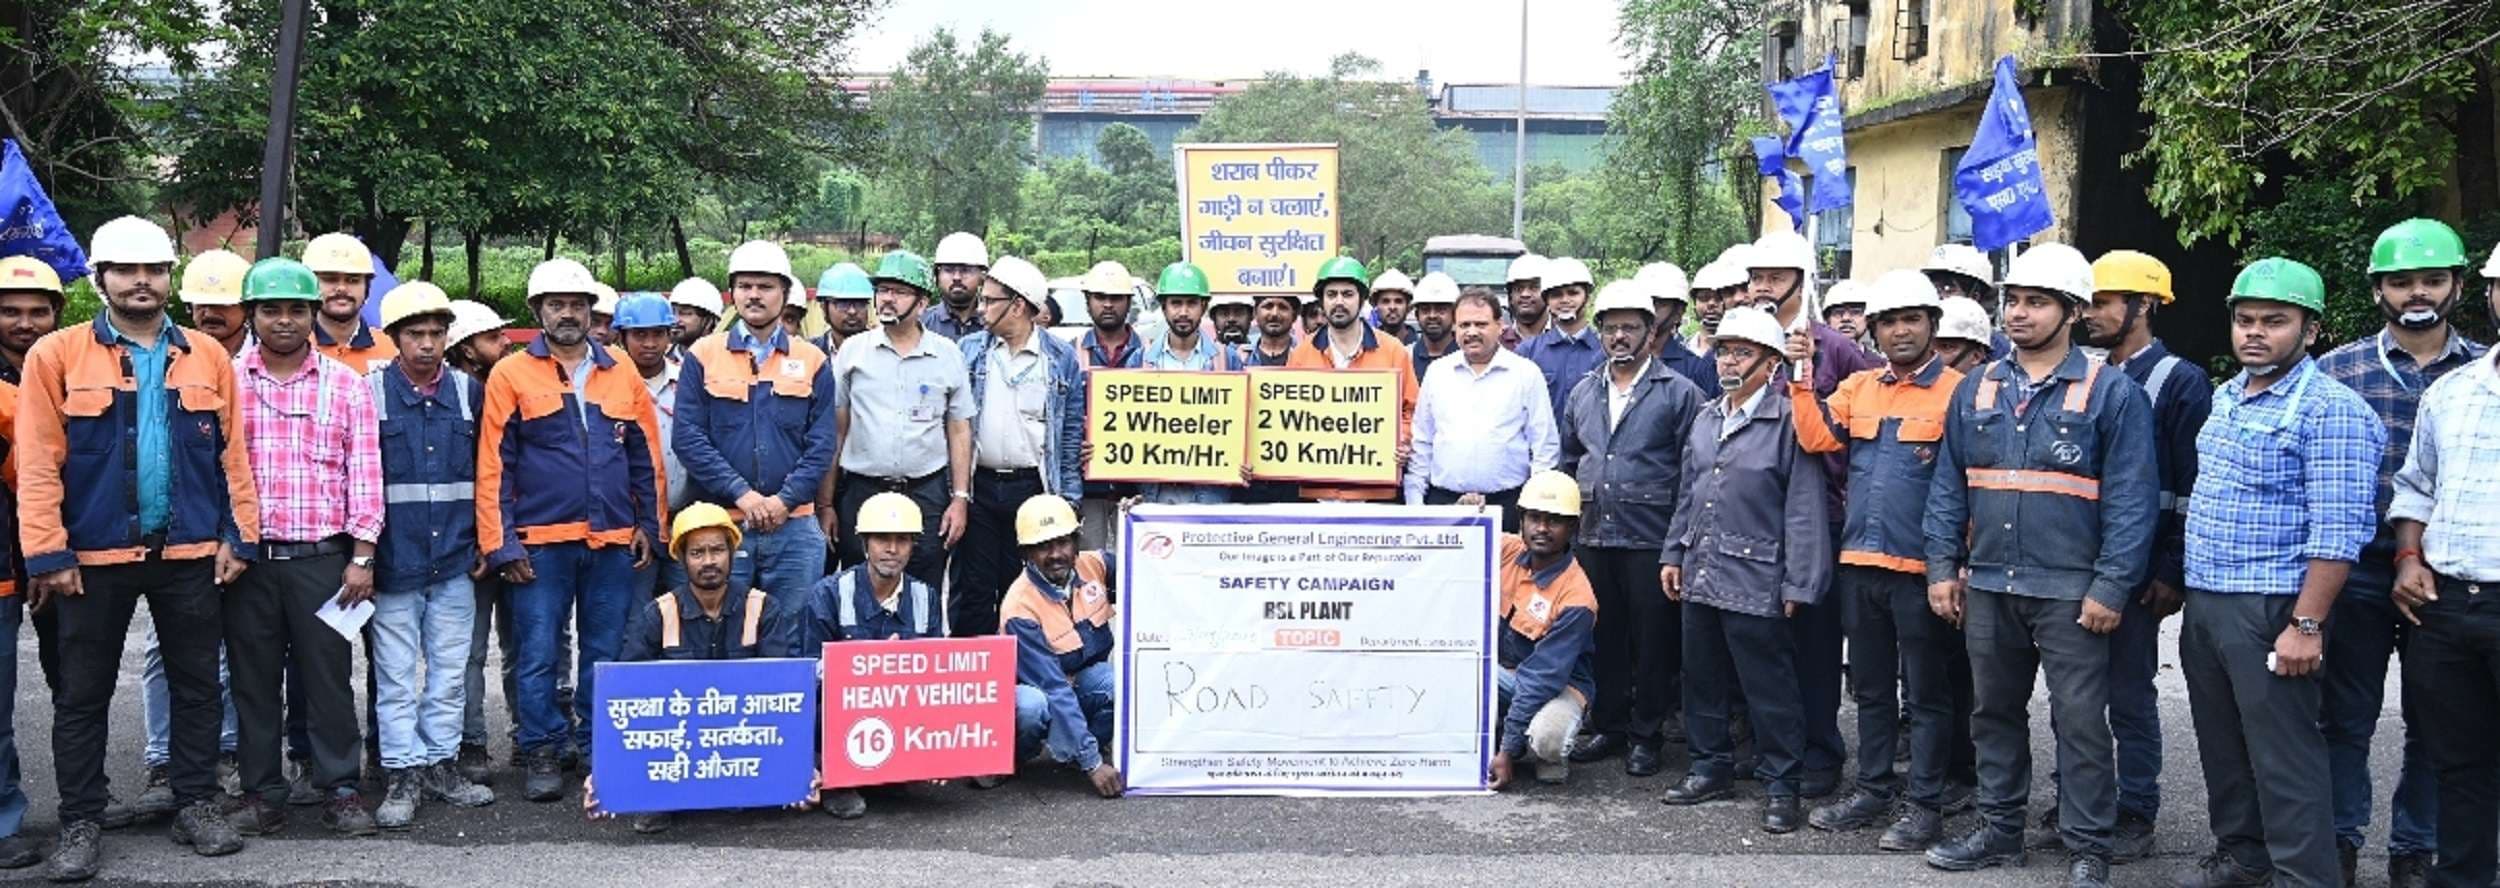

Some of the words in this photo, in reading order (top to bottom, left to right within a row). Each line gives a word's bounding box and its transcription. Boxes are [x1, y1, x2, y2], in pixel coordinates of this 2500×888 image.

[1211, 163, 1260, 181] शराब
[1266, 156, 1319, 181] पीकर
[1198, 194, 1241, 221] गाड़ी
[1247, 199, 1264, 216] न
[1270, 192, 1329, 217] चलाएं,
[1198, 229, 1253, 251] जीवन
[1258, 229, 1325, 257] सुरक्षित
[1105, 384, 1173, 403] SPEED
[1180, 386, 1232, 405] LIMIT
[1259, 382, 1325, 403] SPEED
[1331, 386, 1383, 403] LIMIT
[1103, 411, 1117, 432] 2
[1126, 411, 1232, 436] Wheeler
[1258, 409, 1272, 429] 2
[1280, 409, 1384, 434] Wheeler
[1103, 442, 1134, 465] 30
[1142, 442, 1229, 467] Km/Hr.
[1260, 440, 1288, 463] 30
[1298, 442, 1383, 467] Km/Hr.
[1182, 531, 1254, 543] Protective
[1258, 532, 1314, 545] General
[1318, 533, 1402, 547] Engineering
[1406, 534, 1433, 545] Pvt.
[1437, 533, 1464, 545] Ltd.
[1219, 577, 1290, 590] SAFETY
[1297, 577, 1395, 591] CAMPAIGN
[1263, 601, 1296, 620] BSL
[1300, 601, 1353, 620] PLANT
[1279, 631, 1335, 645] TOPIC
[852, 653, 927, 676] SPEED
[934, 651, 990, 673] LIMIT
[842, 684, 910, 709] HEAVY
[915, 680, 998, 706] VEHICLE
[1163, 661, 1270, 717] ROAD
[607, 697, 665, 729] सुरक्षा
[669, 689, 692, 716] के
[697, 687, 737, 715] तीन
[852, 728, 886, 754] 16
[903, 722, 998, 752] Km/Hr.
[648, 751, 689, 782] सही
[694, 750, 761, 779] औजार
